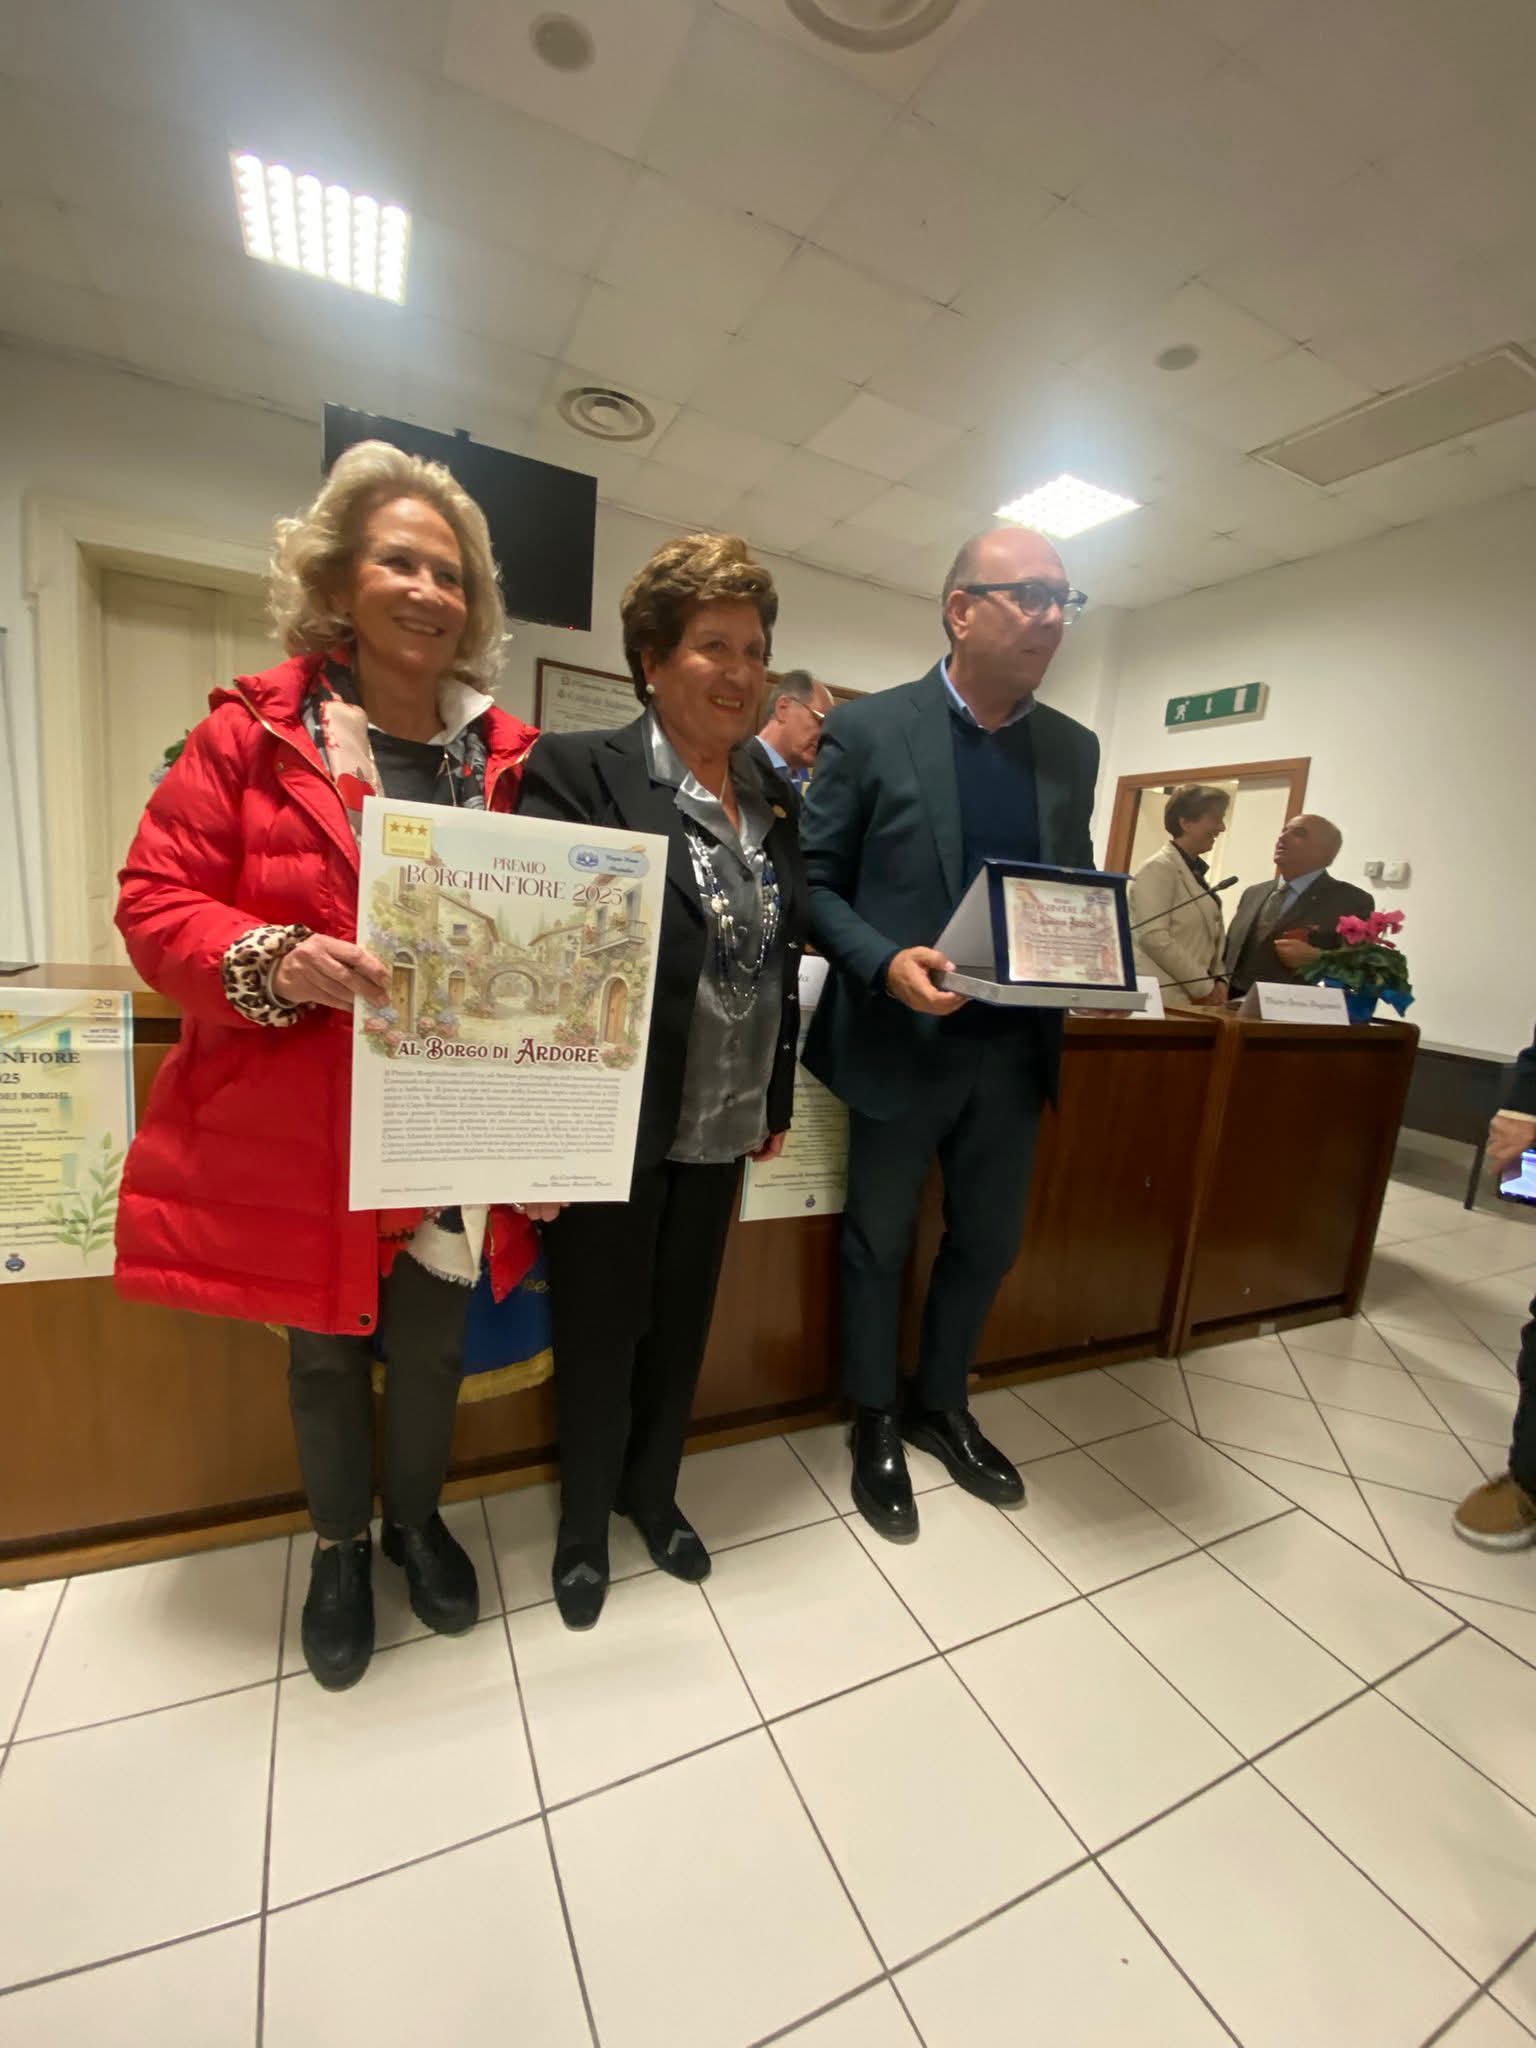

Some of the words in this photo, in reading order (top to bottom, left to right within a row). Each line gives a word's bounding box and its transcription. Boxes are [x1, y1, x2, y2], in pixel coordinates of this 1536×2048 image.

[493, 856, 546, 874] PREMIO
[406, 864, 565, 899] BORGHINFIORE
[572, 884, 623, 905] 2025
[95, 998, 113, 1009] 29
[397, 1042, 420, 1056] AL
[425, 1037, 488, 1060] BORGO
[492, 1046, 509, 1059] DI
[514, 1038, 599, 1065] ARDORE
[0, 1072, 21, 1084] 25
